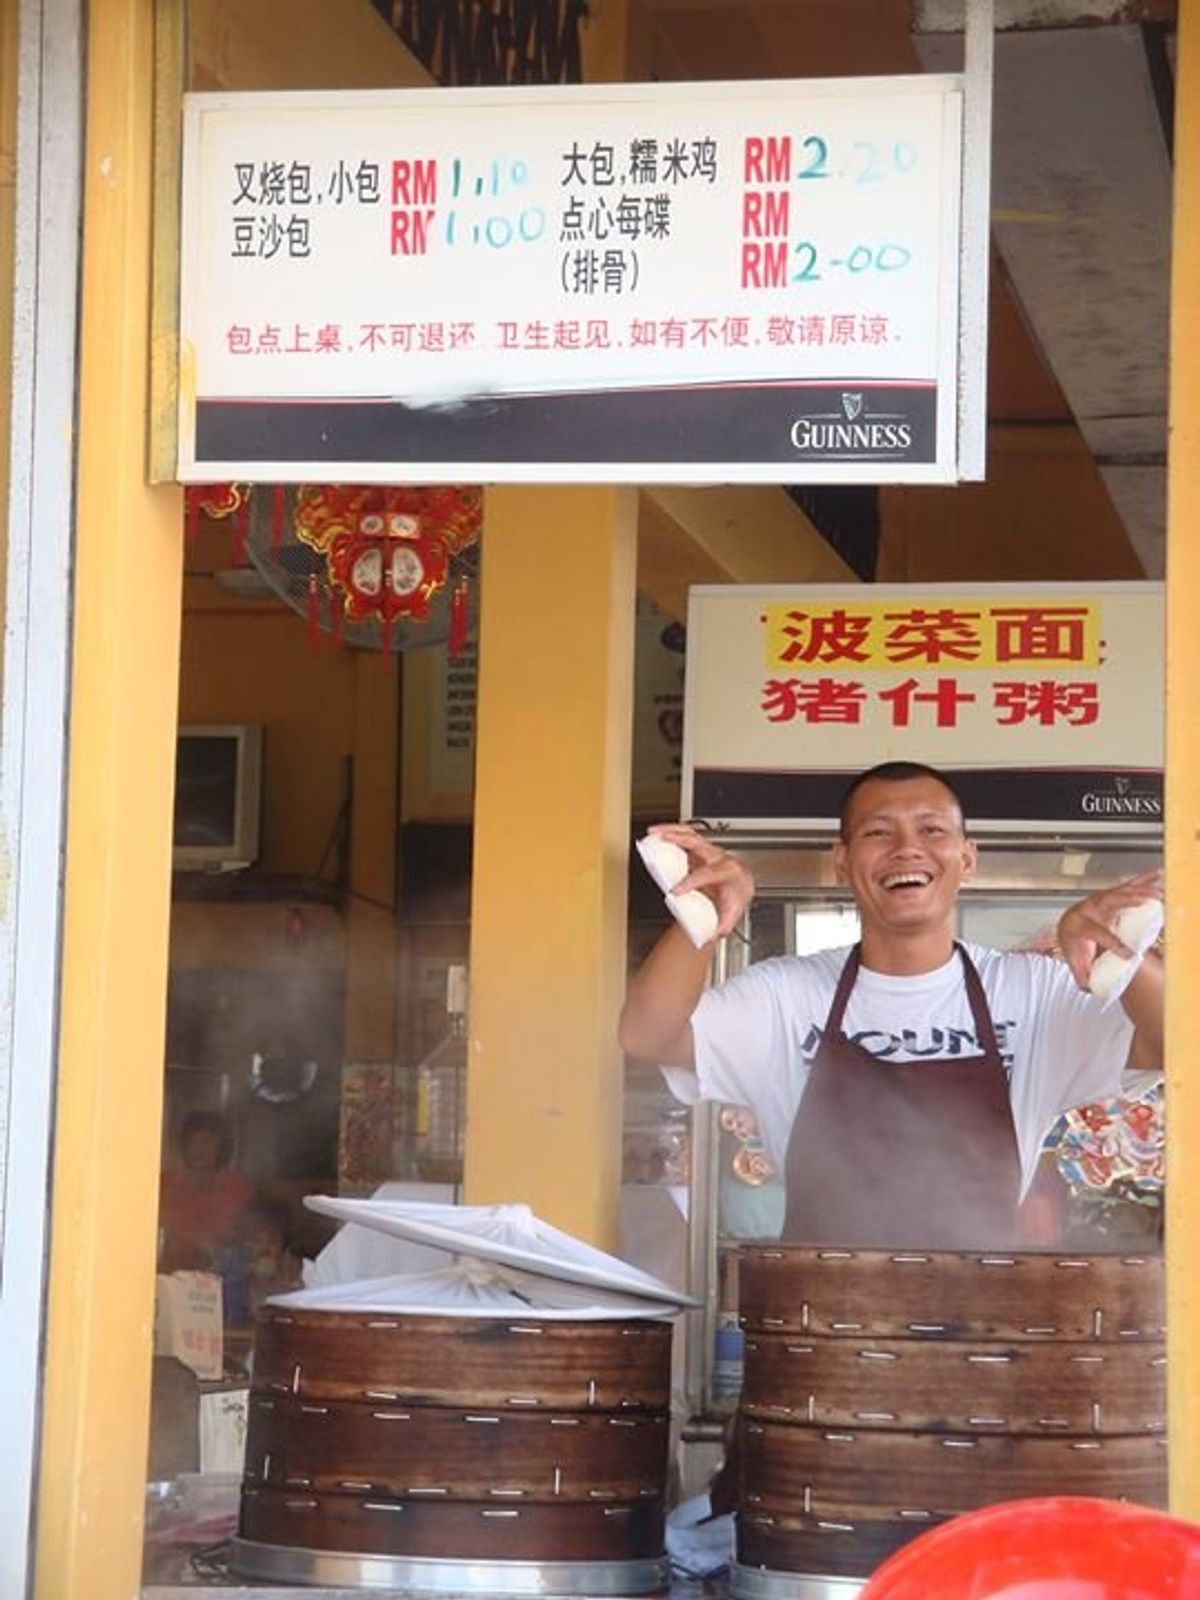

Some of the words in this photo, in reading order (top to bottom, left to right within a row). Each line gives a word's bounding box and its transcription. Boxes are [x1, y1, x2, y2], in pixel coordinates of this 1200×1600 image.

[232, 160, 381, 205] 叉烧包,小包
[392, 160, 436, 205] RM
[561, 136, 718, 187] 大包,糯米鸡
[744, 136, 791, 183] RM
[231, 214, 312, 260] 豆沙包
[560, 193, 671, 241] 点心每碟
[743, 191, 789, 237] RM
[561, 249, 639, 294] (排骨)
[741, 243, 788, 288] RM
[791, 419, 911, 449] GUINNESS
[779, 608, 1089, 663] 波菜面
[761, 678, 1099, 727] 猪什粥
[1082, 792, 1161, 815] GUINNESS
